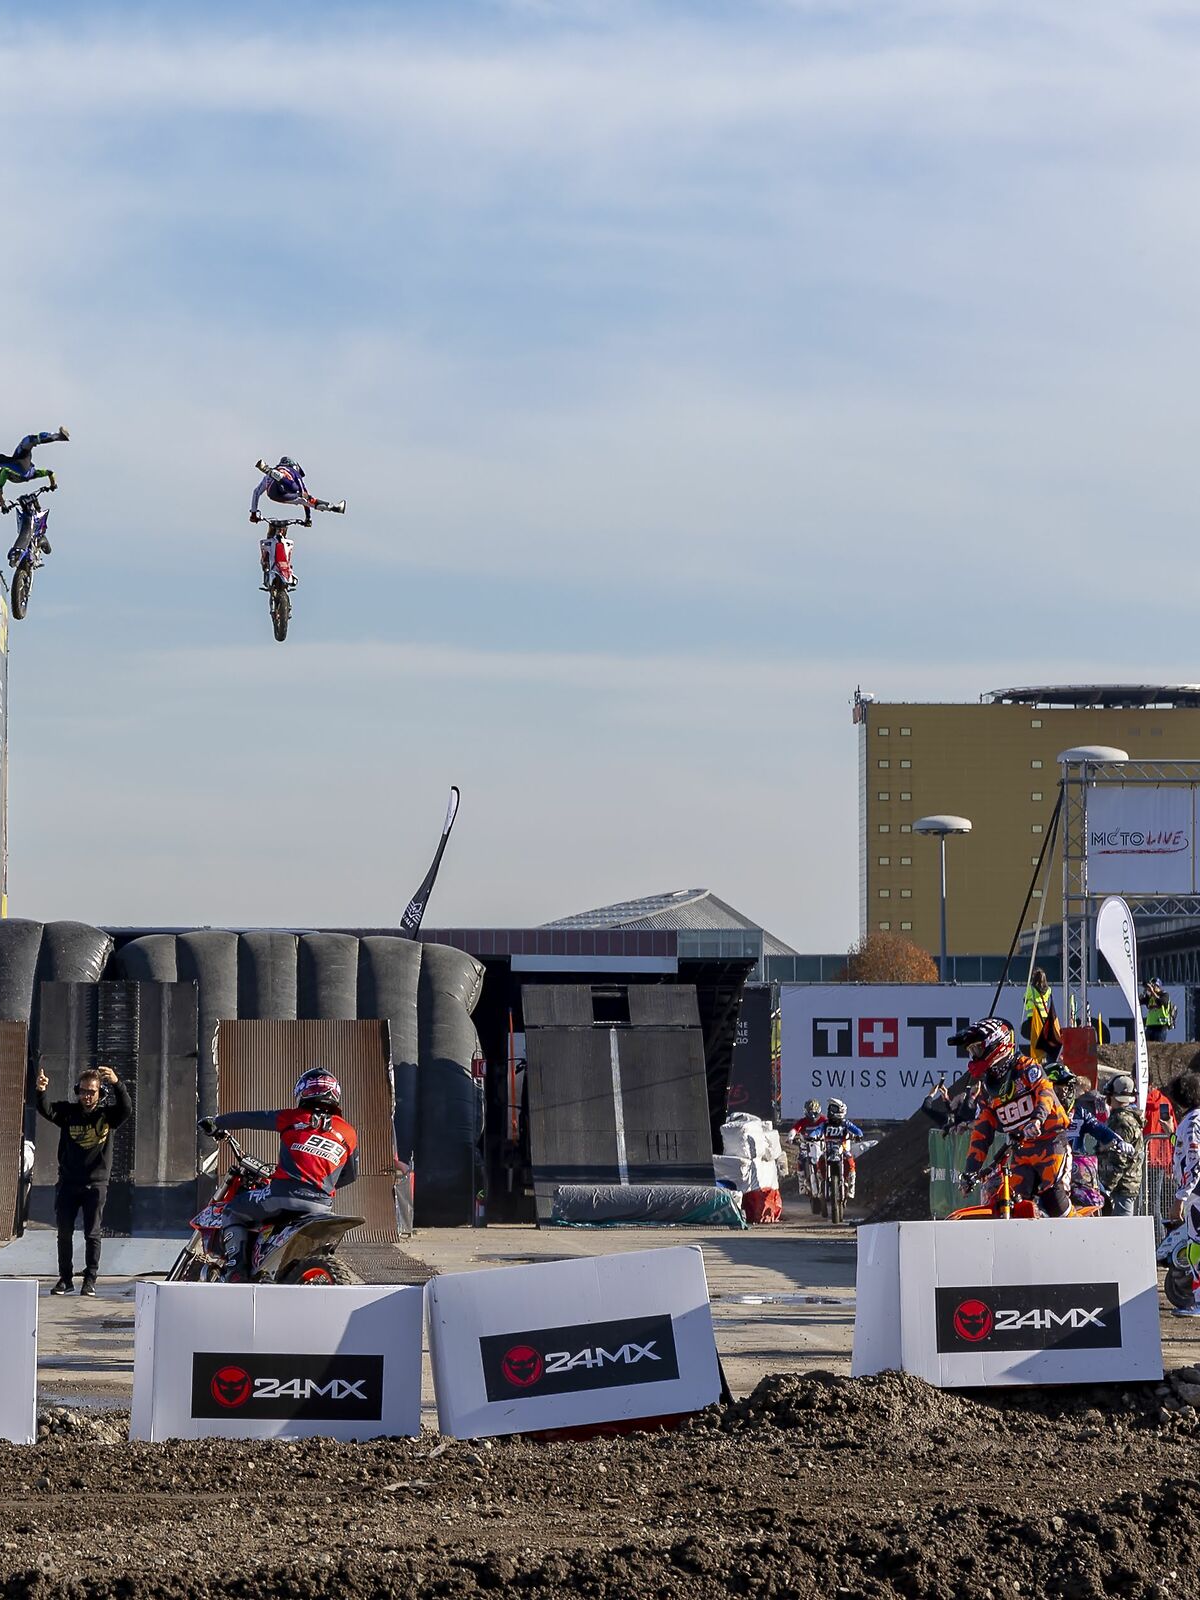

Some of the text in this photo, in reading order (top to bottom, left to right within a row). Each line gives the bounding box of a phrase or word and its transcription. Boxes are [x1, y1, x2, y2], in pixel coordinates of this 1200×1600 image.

[812, 1070, 887, 1088] SWISS
[826, 1127, 845, 1136] FOX
[308, 1135, 345, 1156] 929
[995, 1308, 1106, 1330] 24MX
[545, 1341, 661, 1373] 24MX
[253, 1379, 367, 1399] 24MX
